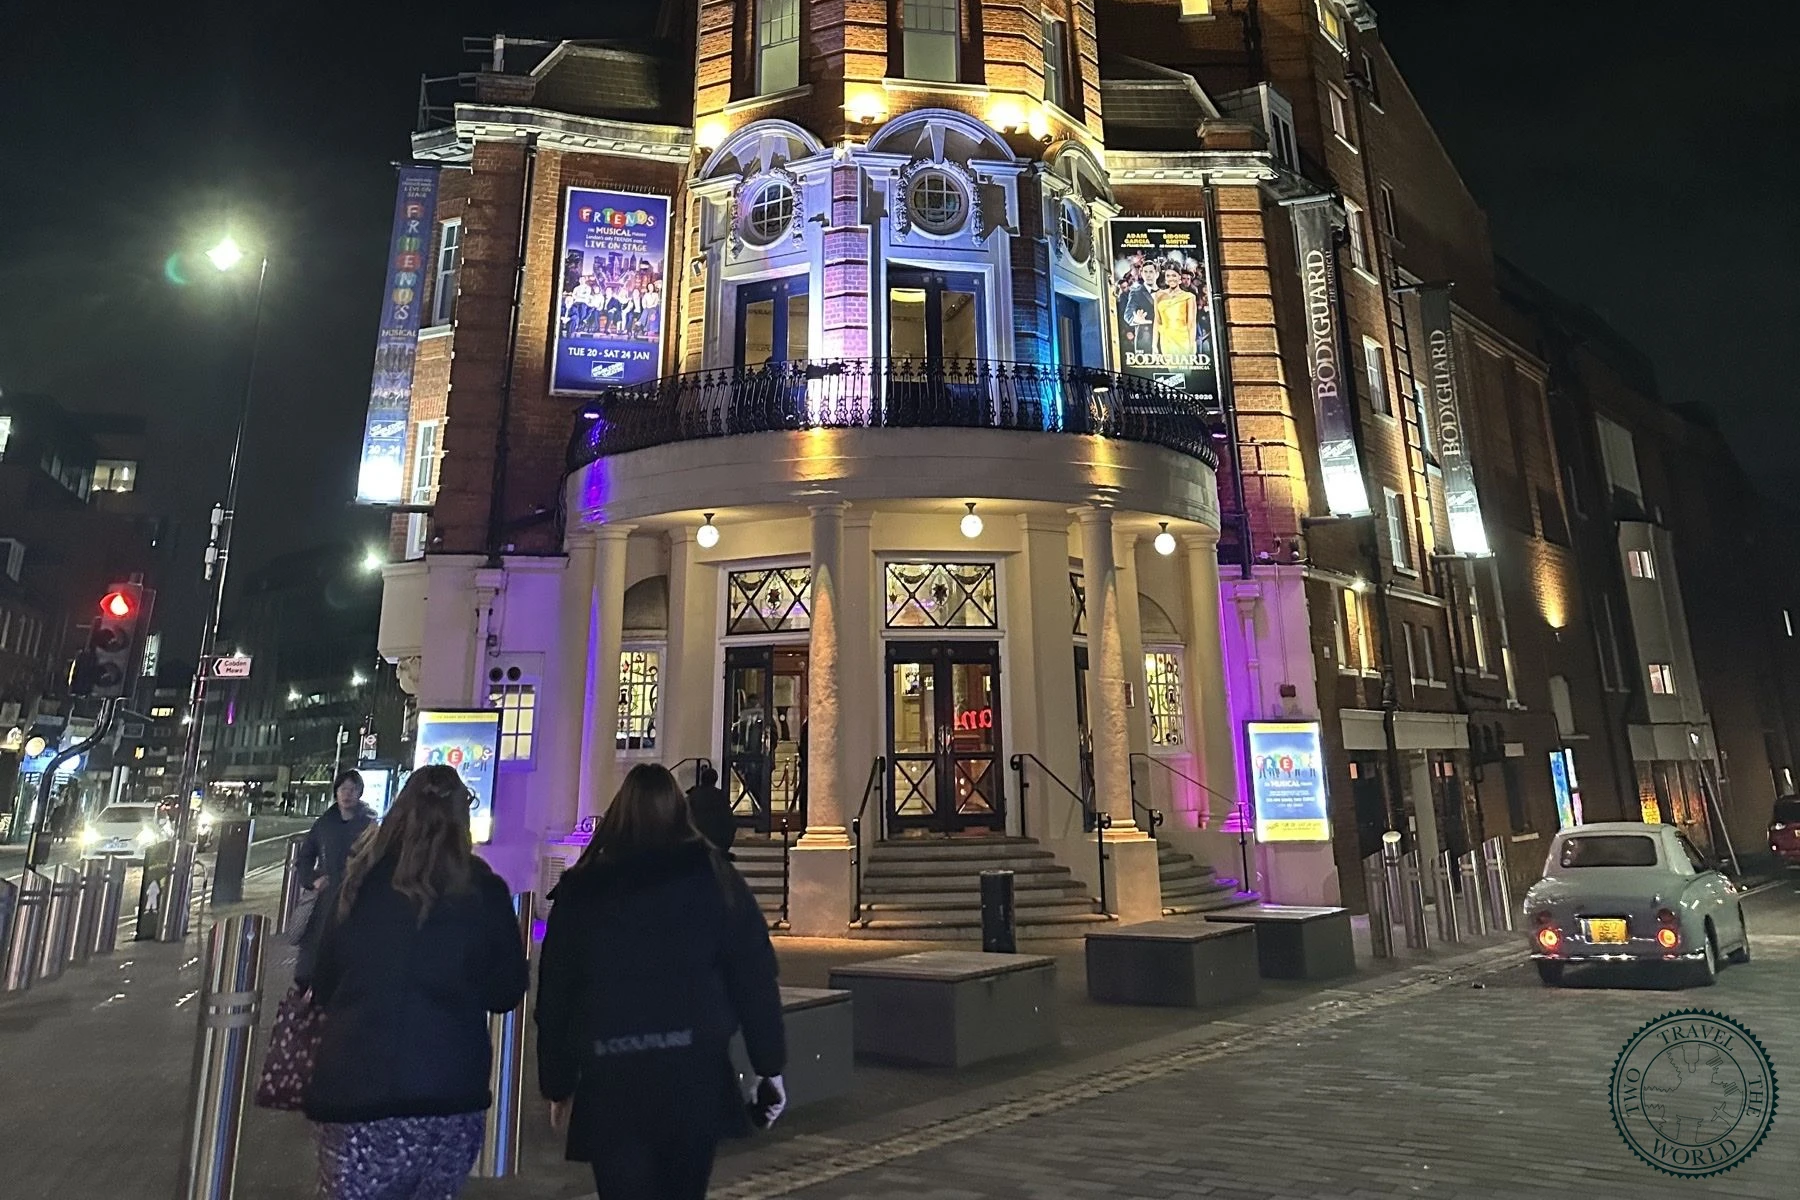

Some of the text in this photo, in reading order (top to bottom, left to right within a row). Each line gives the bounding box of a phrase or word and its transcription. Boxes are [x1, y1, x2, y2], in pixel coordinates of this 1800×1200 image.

[581, 206, 656, 228] FRIENDS
[596, 226, 632, 237] MUSICAL
[585, 240, 648, 252] LIVE ON STAGE
[1325, 250, 1334, 286] MUSICAL
[1306, 249, 1338, 400] BODYGUARD
[568, 347, 586, 356] TUE
[587, 347, 598, 357] 20
[603, 349, 620, 358] SAT
[620, 350, 631, 359] 24
[633, 351, 650, 360] JAN
[1125, 352, 1210, 366] BODYGUARD
[1430, 329, 1461, 457] BODYGUARD
